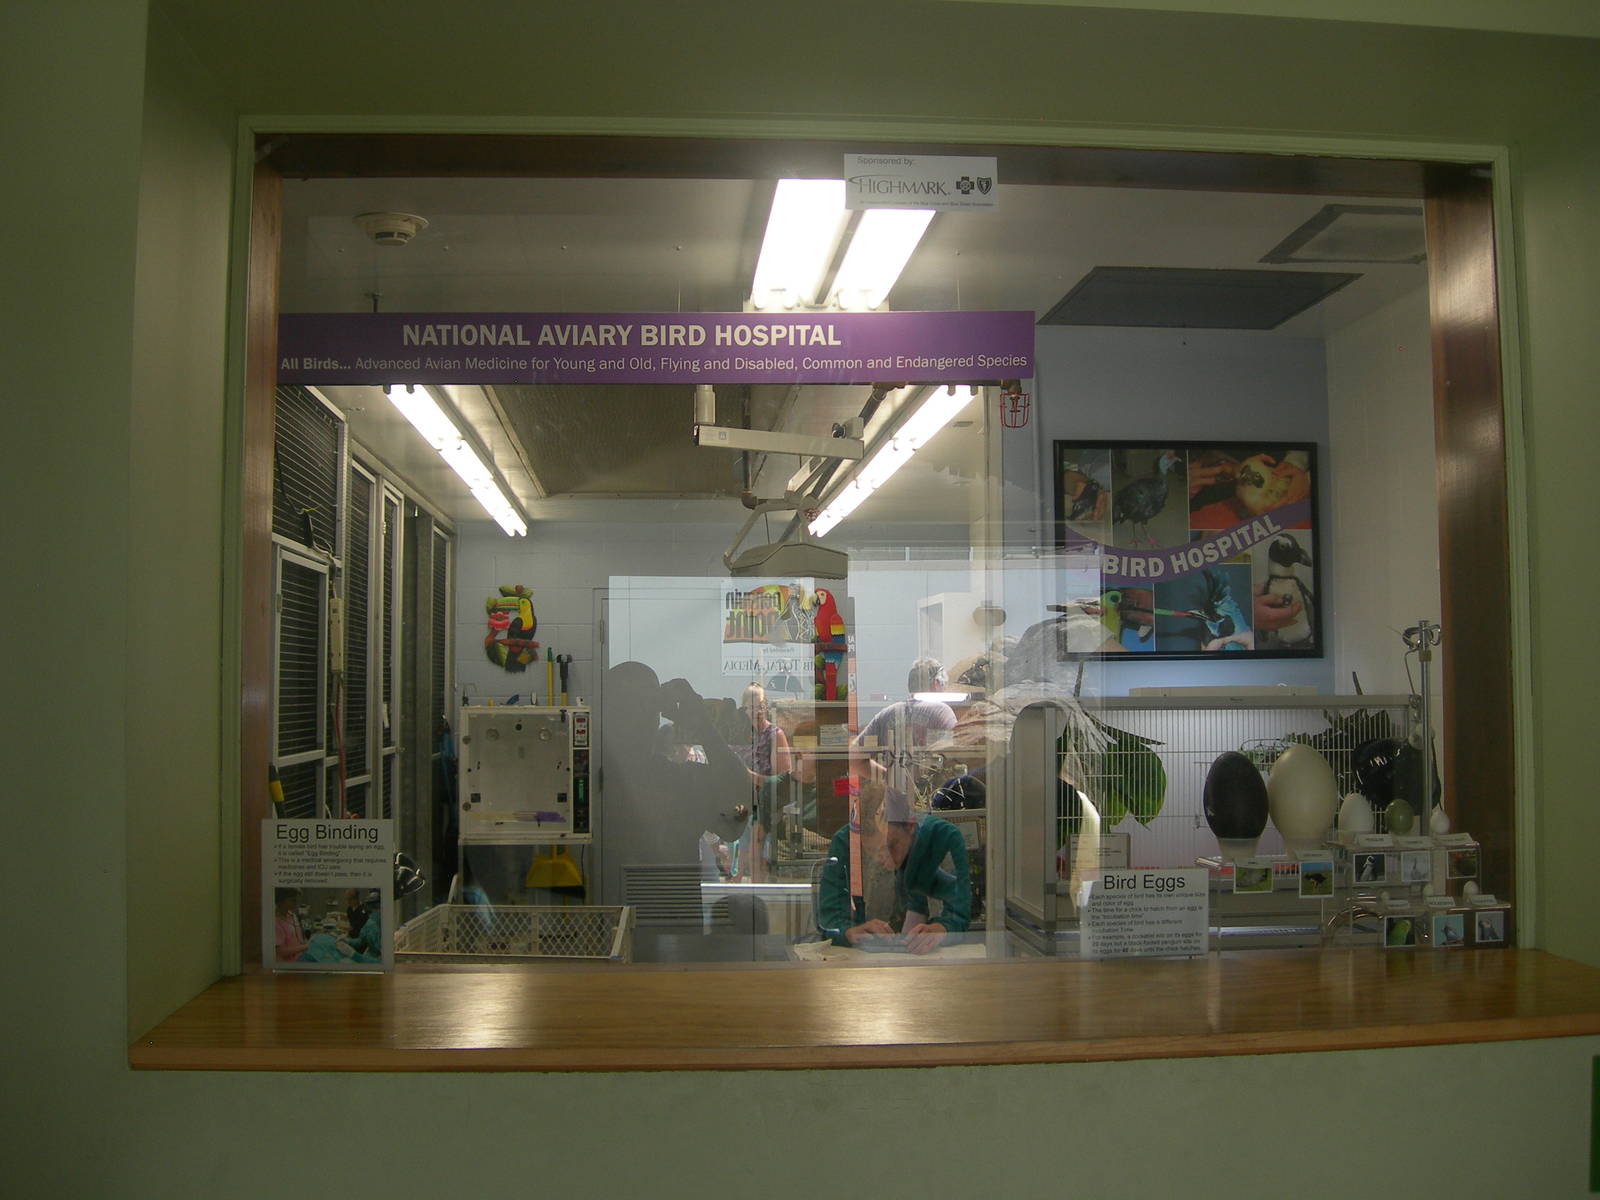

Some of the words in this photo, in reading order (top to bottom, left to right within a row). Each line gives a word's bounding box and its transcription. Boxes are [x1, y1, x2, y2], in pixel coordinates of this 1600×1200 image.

[857, 156, 901, 166] Sponsored
[403, 324, 530, 346] NATIONAL
[537, 324, 633, 346] AVIARY
[641, 324, 706, 346] BIRD
[715, 324, 842, 346] HOSPITAL
[281, 357, 299, 370] All
[303, 357, 351, 370] Birds...
[355, 357, 421, 370] Advanced
[424, 357, 461, 370] Avian
[465, 357, 528, 370] Medicine
[532, 357, 550, 370] for
[553, 357, 594, 373] Young
[599, 357, 625, 370] and
[629, 357, 656, 372] Old,
[660, 357, 700, 372] Flying
[703, 357, 730, 370] and
[735, 357, 798, 371] Disabled,
[802, 356, 863, 370] Common
[866, 355, 892, 369] and
[896, 354, 974, 371] Endangered
[977, 353, 1028, 368] Species
[1102, 553, 1165, 578] BIRD
[1170, 514, 1281, 574] HOSPITAL
[277, 824, 310, 843] Egg
[316, 824, 379, 843] Binding
[1104, 874, 1137, 890] Bird
[1143, 874, 1186, 893] Eggs
